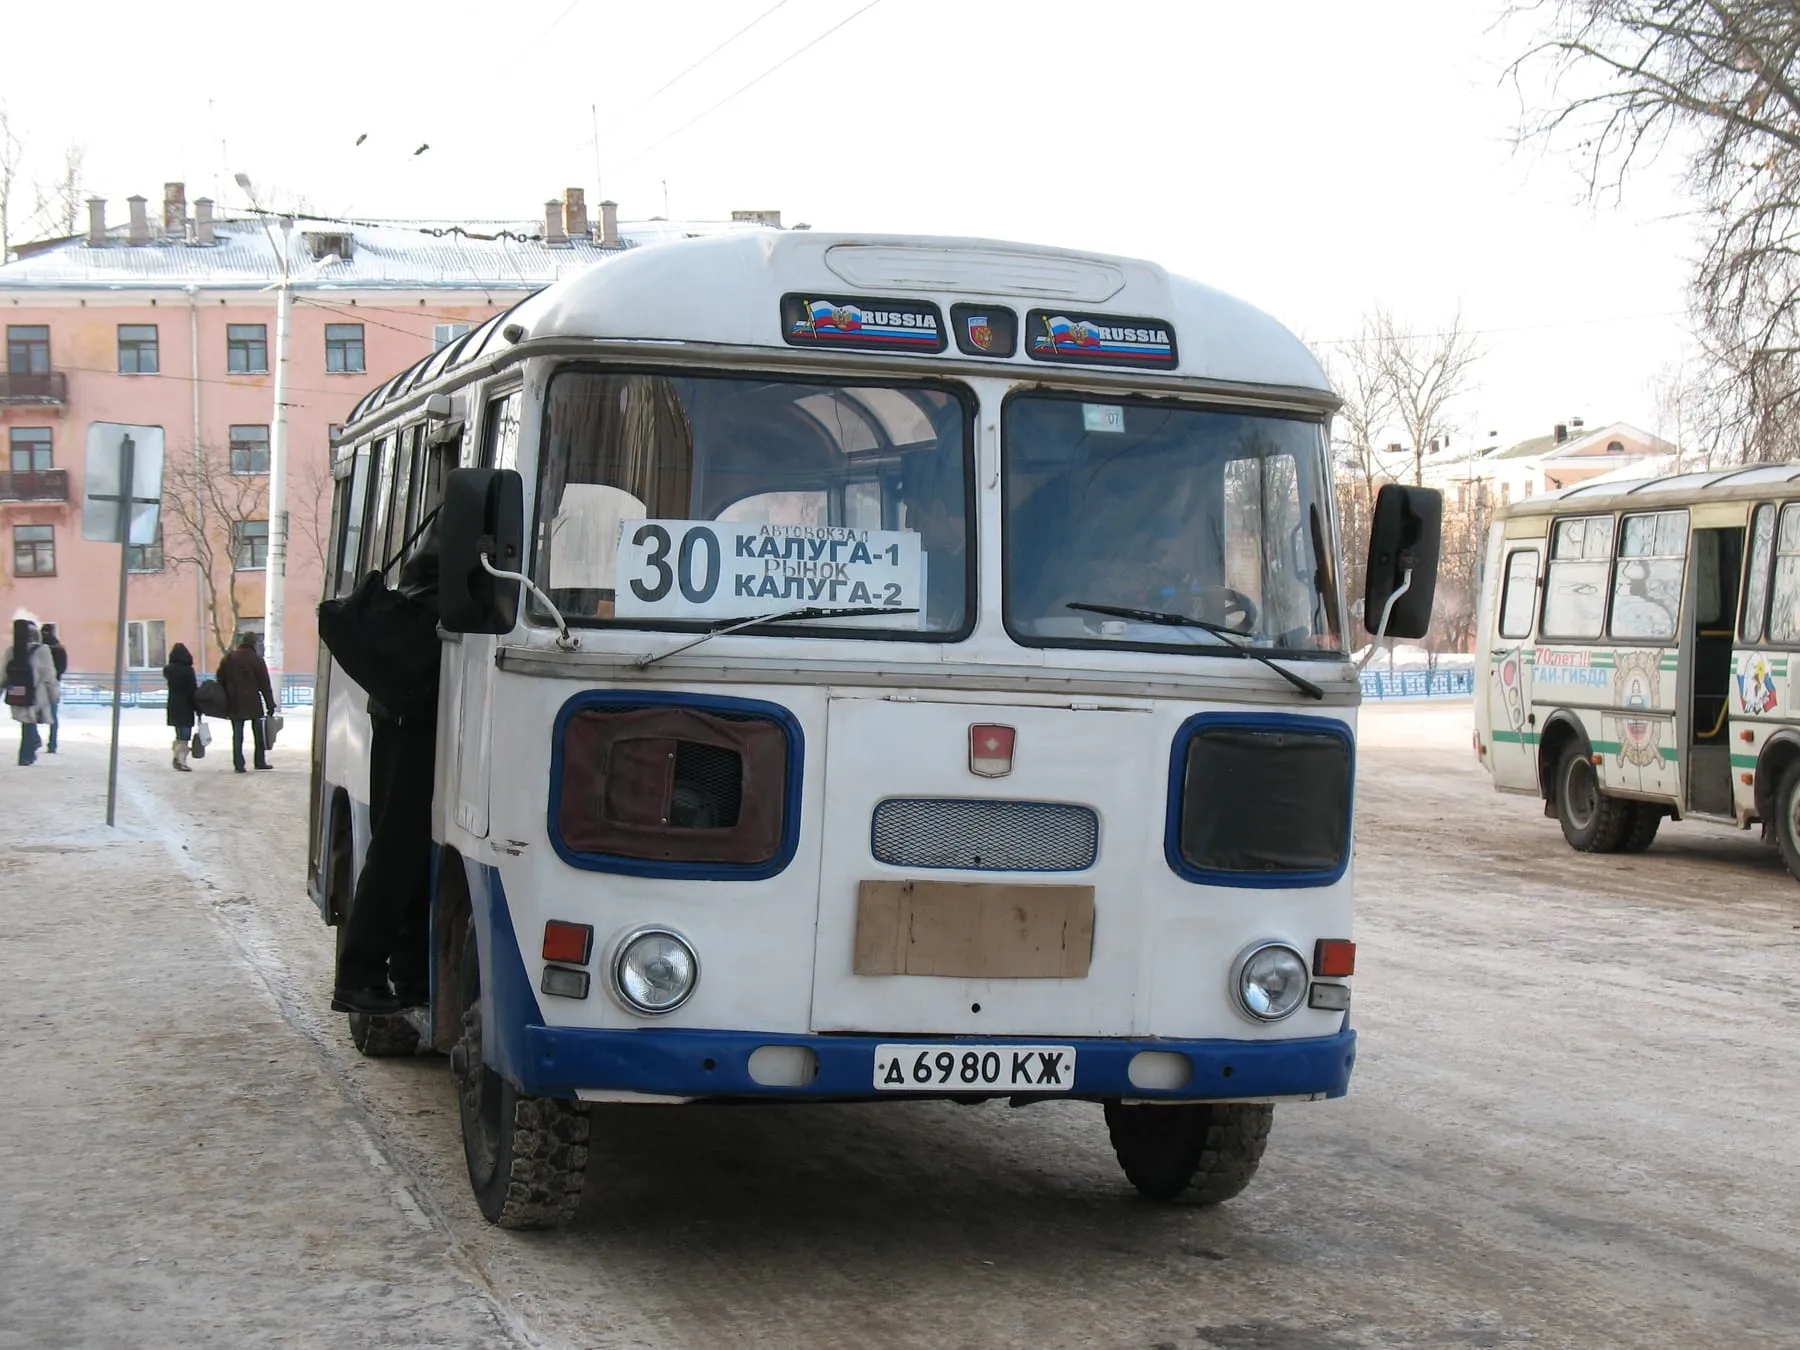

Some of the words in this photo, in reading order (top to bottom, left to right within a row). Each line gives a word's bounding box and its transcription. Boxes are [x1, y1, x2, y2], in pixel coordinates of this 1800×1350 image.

[860, 309, 938, 328] RUSSIA
[1099, 326, 1170, 345] RUSSIA
[759, 524, 869, 542] АВТОВОКЗАЛ
[734, 534, 900, 567] КАЛУГА-1
[629, 524, 721, 604] 30
[763, 558, 850, 581] РЫНОК
[734, 573, 903, 606] КАЛУГА-2
[1536, 647, 1552, 665] 70
[1554, 653, 1575, 666] лет
[1532, 667, 1608, 687] ГАИ-ГИБДД
[912, 1051, 1001, 1084] 6980
[1011, 1052, 1064, 1084] КЖ
